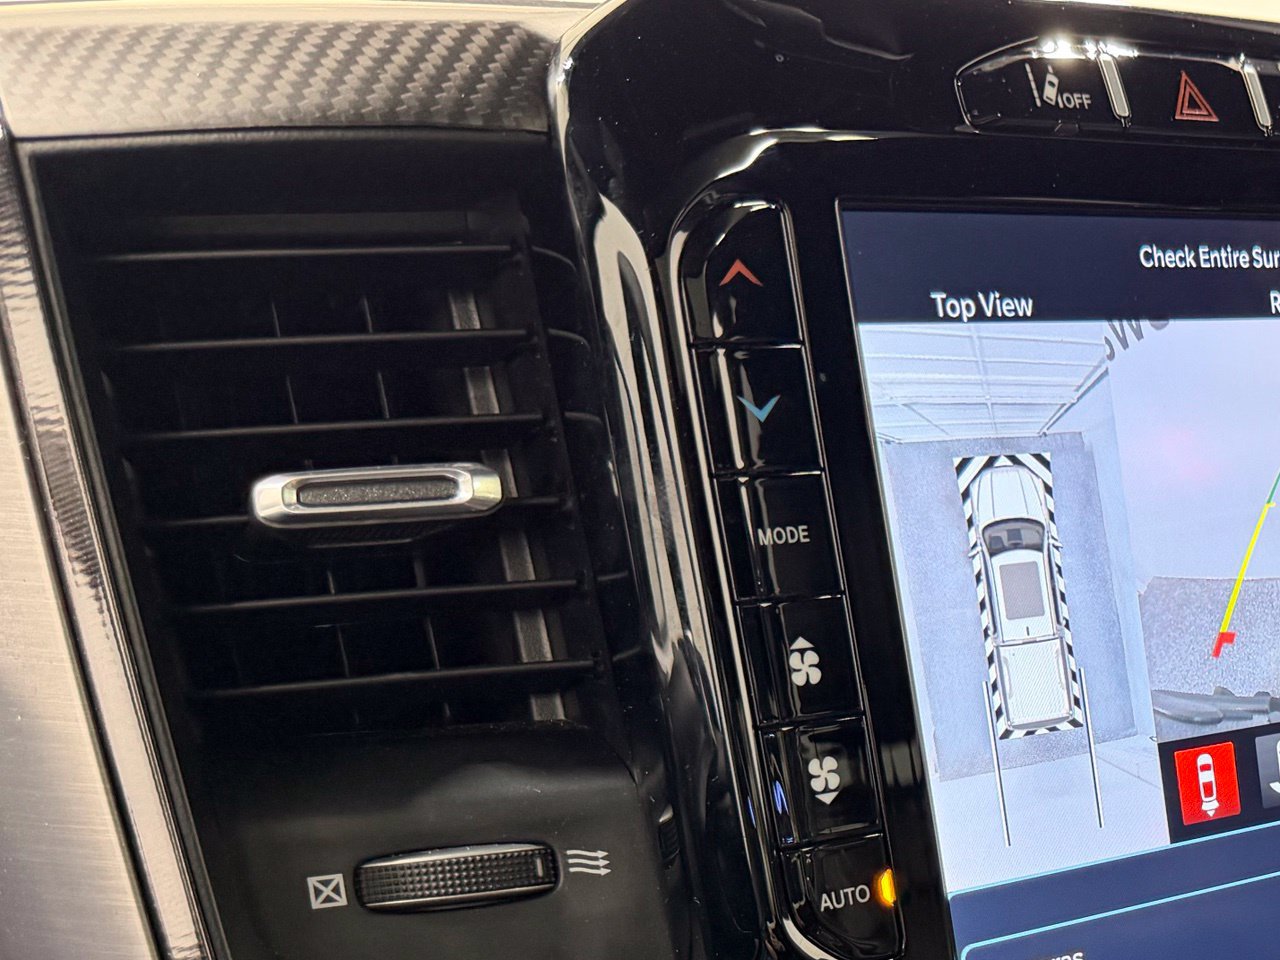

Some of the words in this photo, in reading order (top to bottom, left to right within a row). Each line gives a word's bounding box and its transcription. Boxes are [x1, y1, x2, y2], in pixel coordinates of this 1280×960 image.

[1063, 93, 1092, 110] OFF
[1139, 244, 1196, 270] Check
[1199, 246, 1250, 270] Entire
[930, 291, 978, 323] Top
[978, 291, 1034, 319] View
[757, 525, 811, 546] MODE
[819, 884, 871, 912] AUTO
